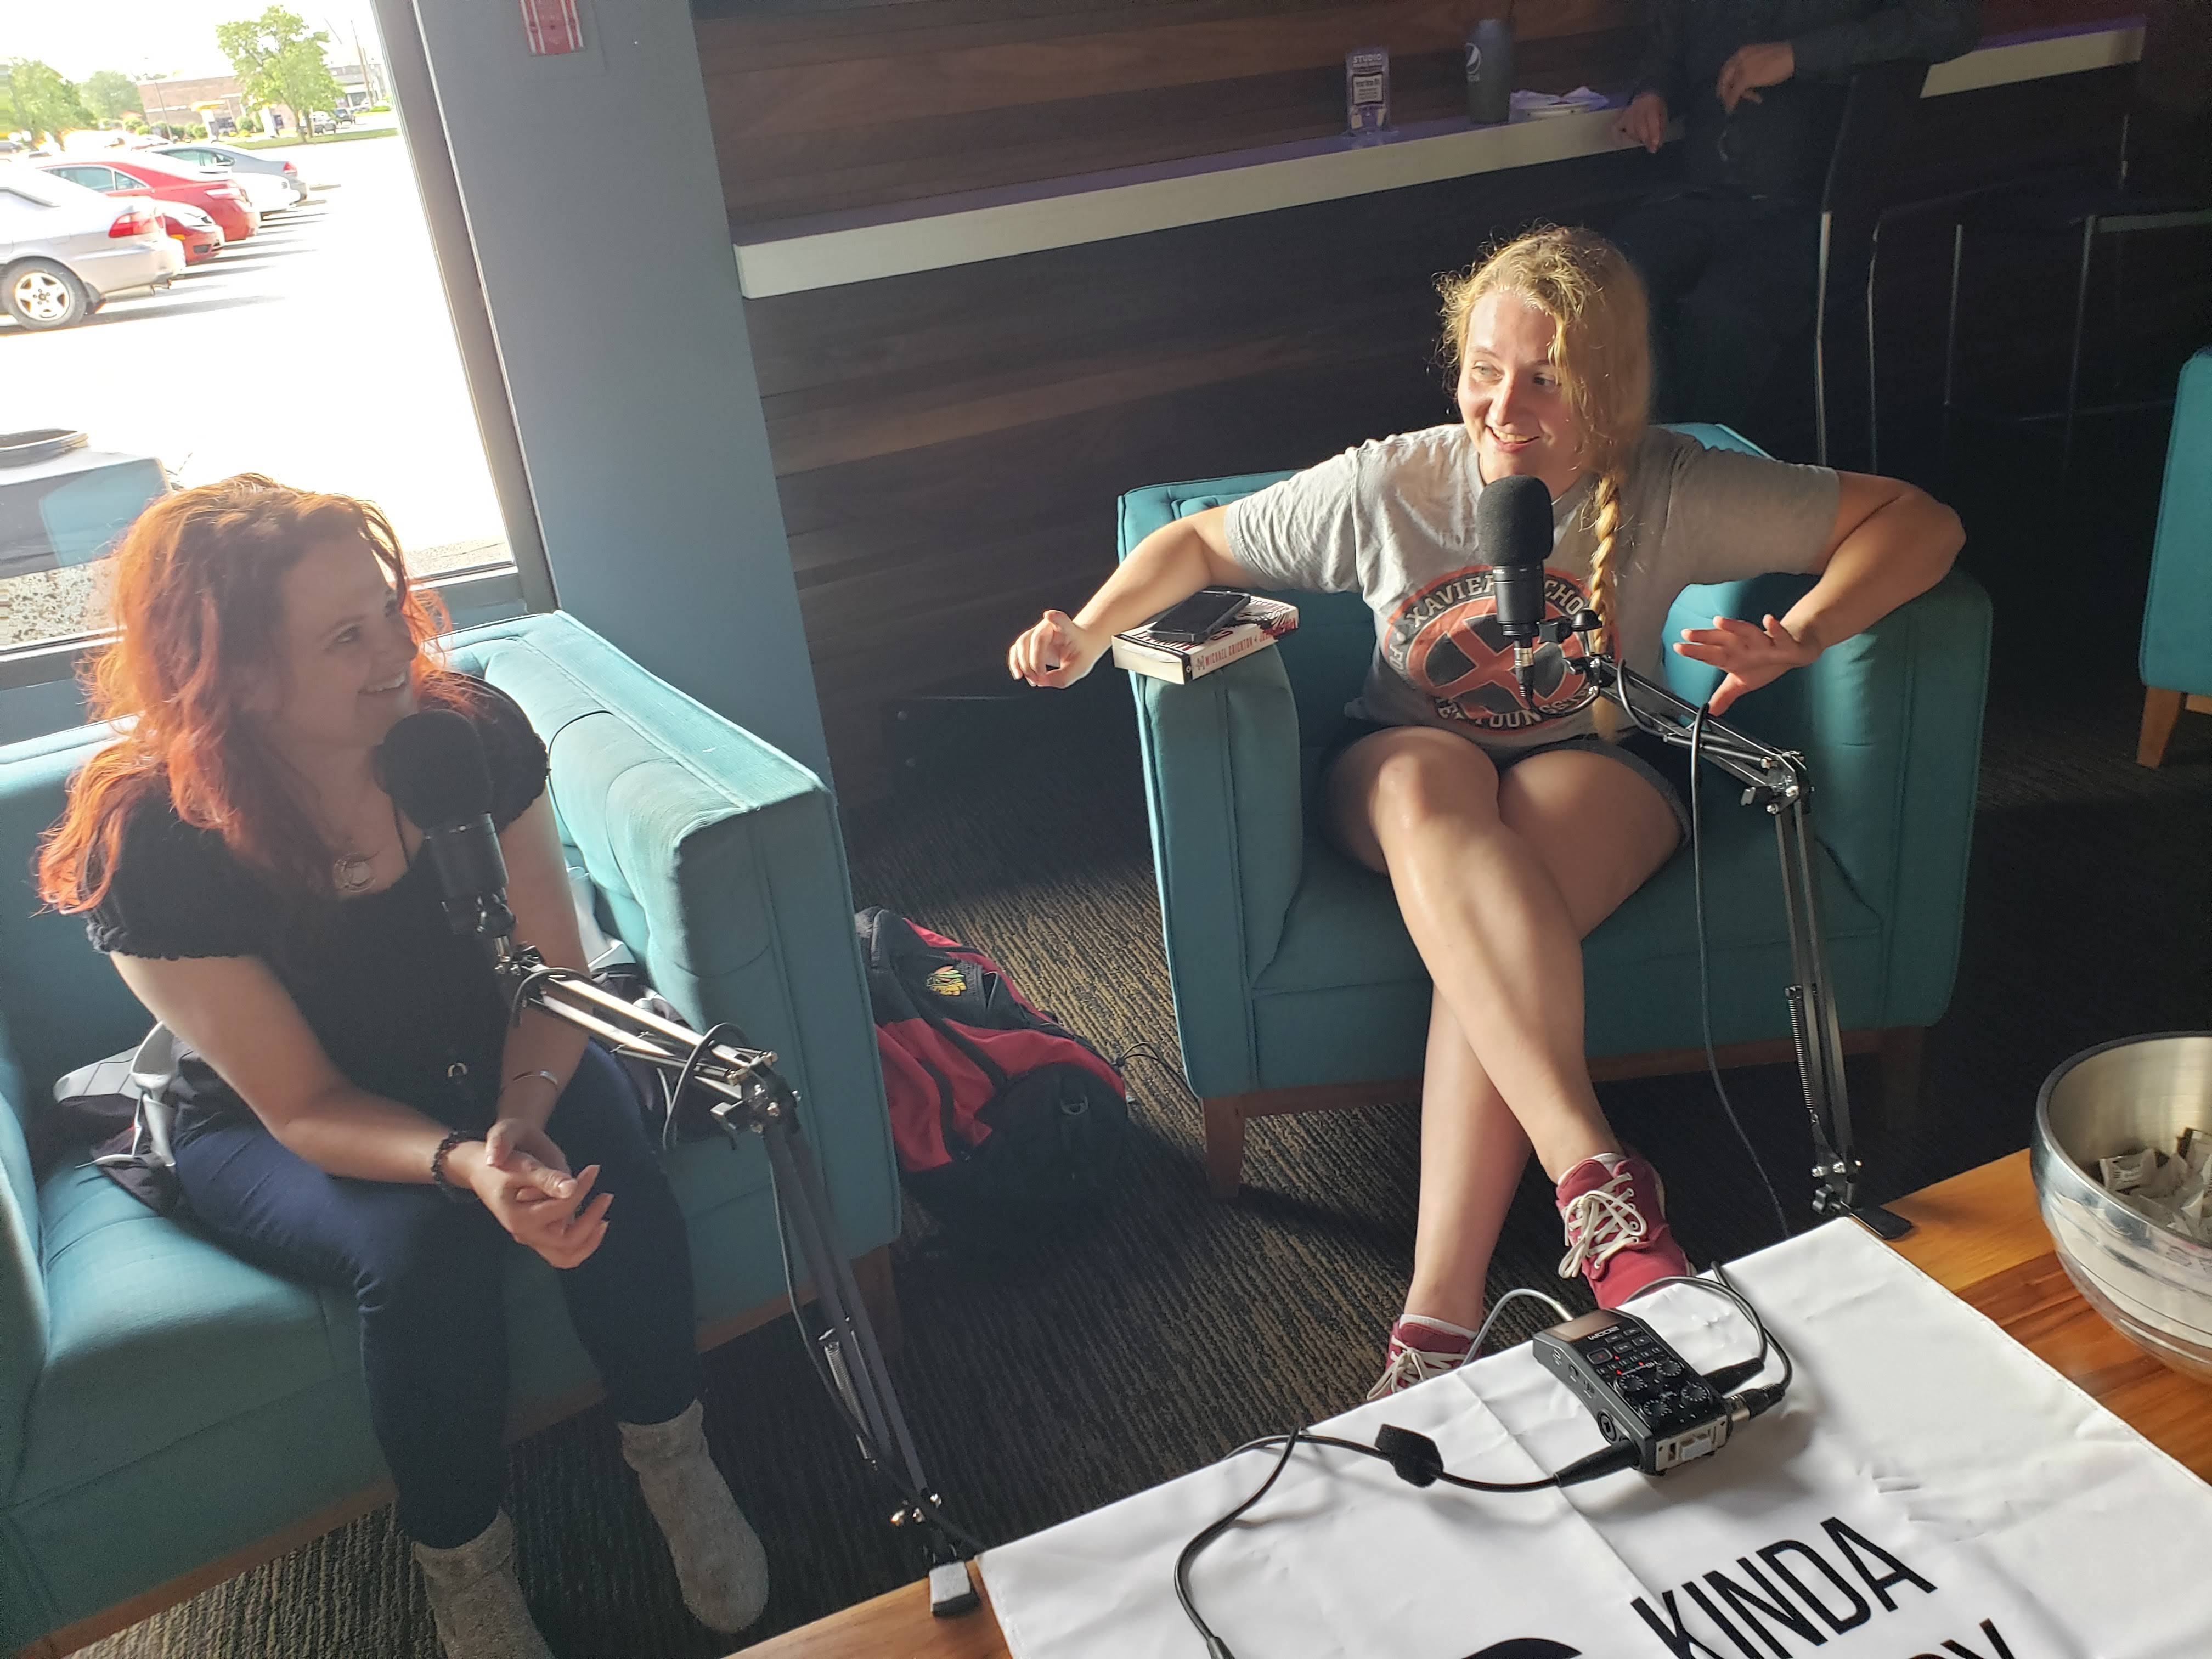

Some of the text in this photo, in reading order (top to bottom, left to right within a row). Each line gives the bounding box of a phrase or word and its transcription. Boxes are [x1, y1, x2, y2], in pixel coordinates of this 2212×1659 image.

[1353, 53, 1382, 63] STUDIO
[1205, 648, 1227, 666] MICHAEL
[1587, 1325, 1620, 1340] ZOOM
[1630, 1516, 1938, 1659] KINDA
